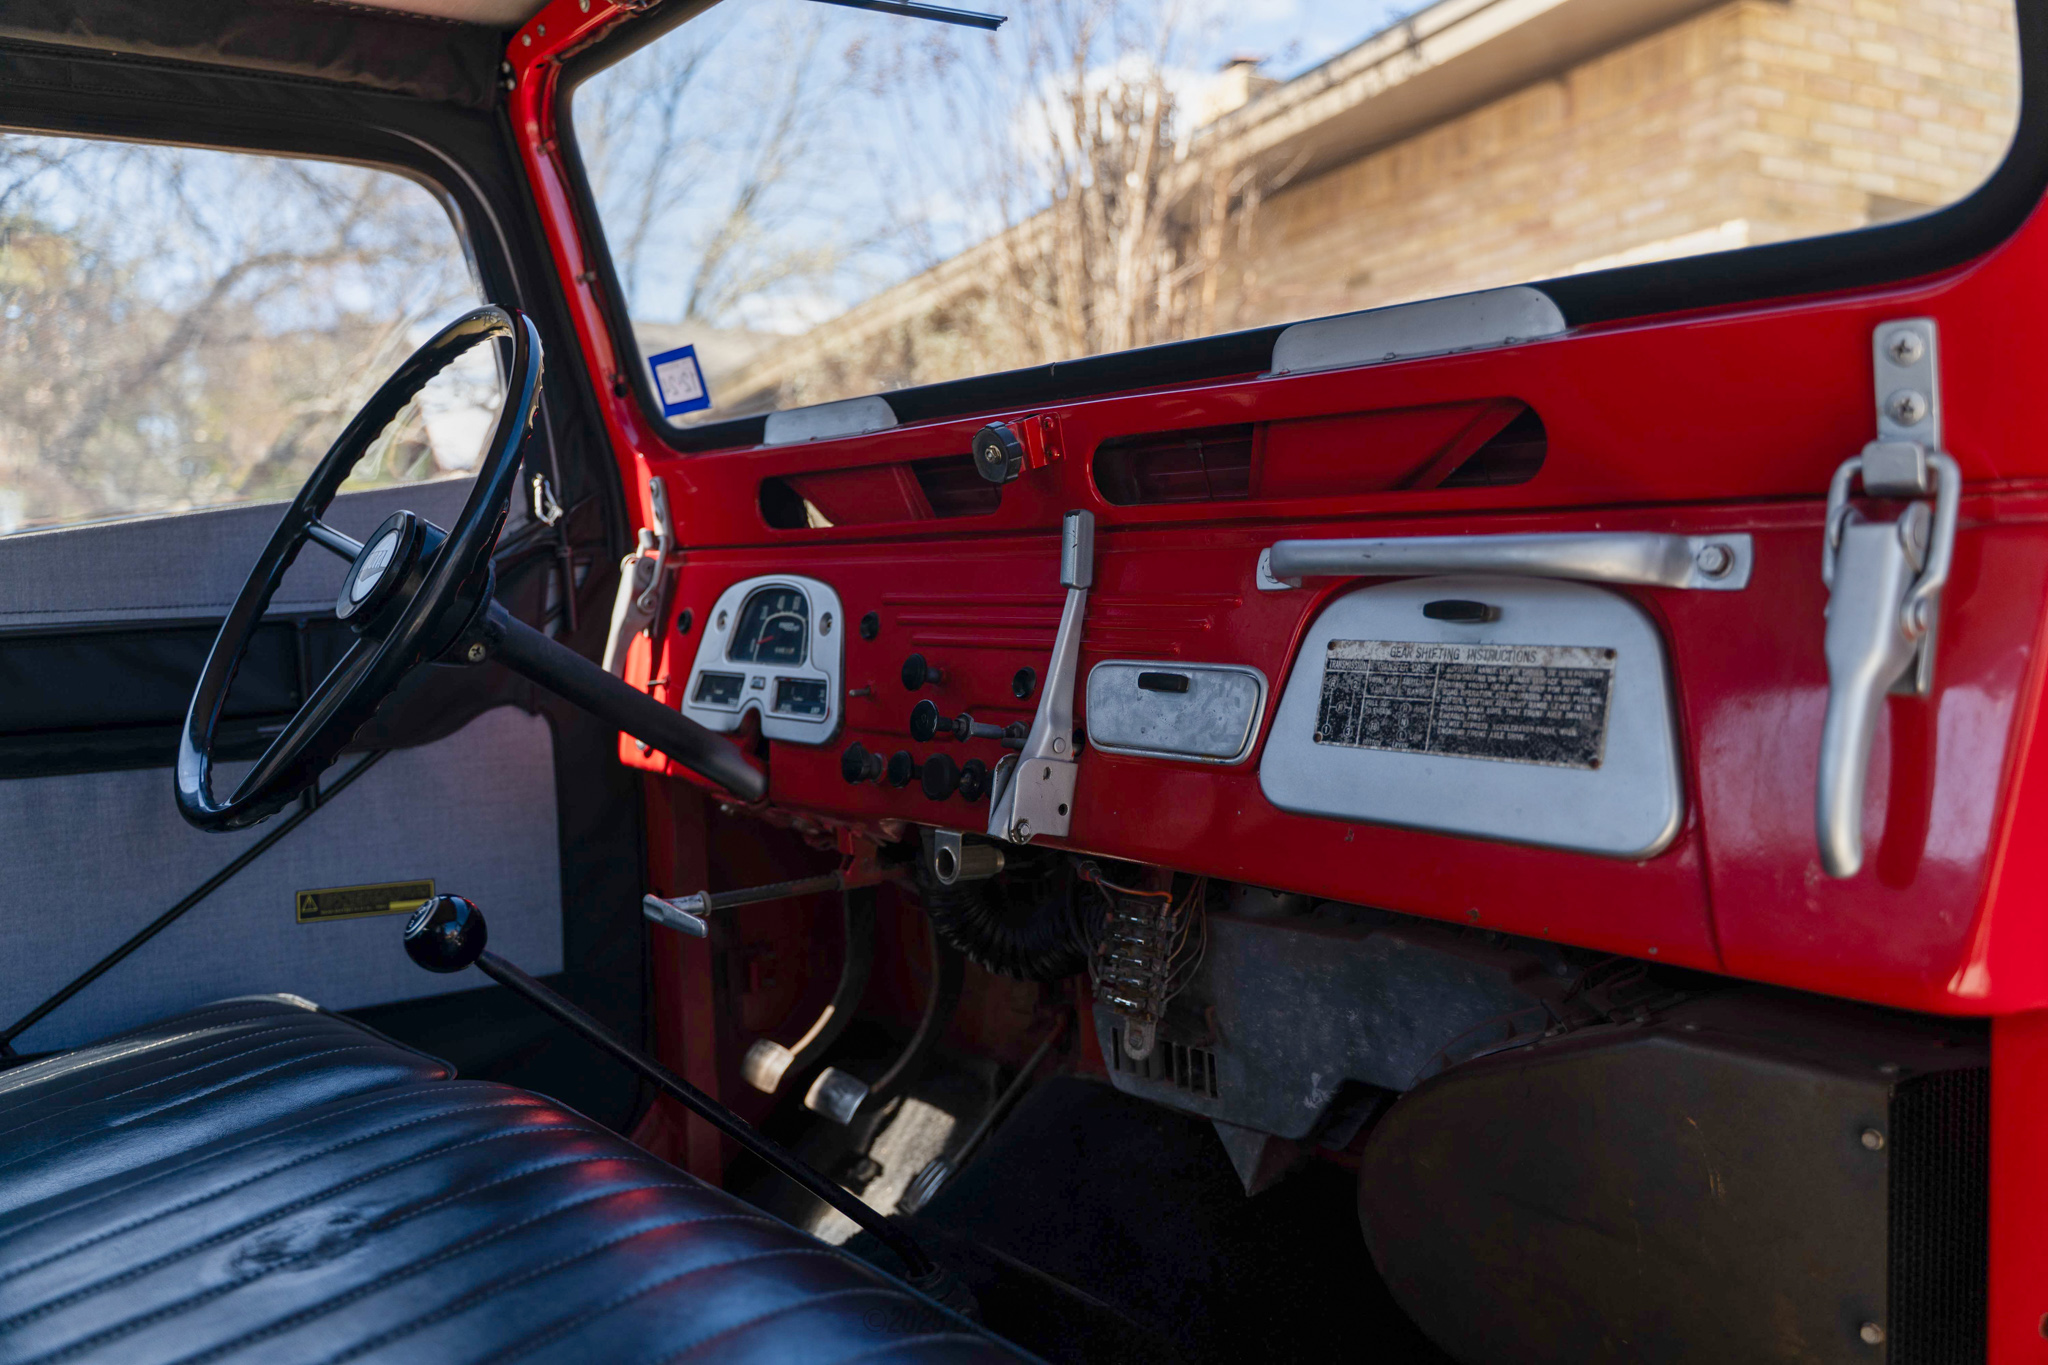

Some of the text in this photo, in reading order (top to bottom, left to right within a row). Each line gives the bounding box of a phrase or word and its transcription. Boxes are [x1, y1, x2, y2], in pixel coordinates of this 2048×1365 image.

[1389, 646, 1537, 662] GEAR SHIFTING INSTRUCTIONS
[1329, 659, 1368, 670] TRANSMISSION
[1377, 661, 1430, 672] TRANSFER CASE
